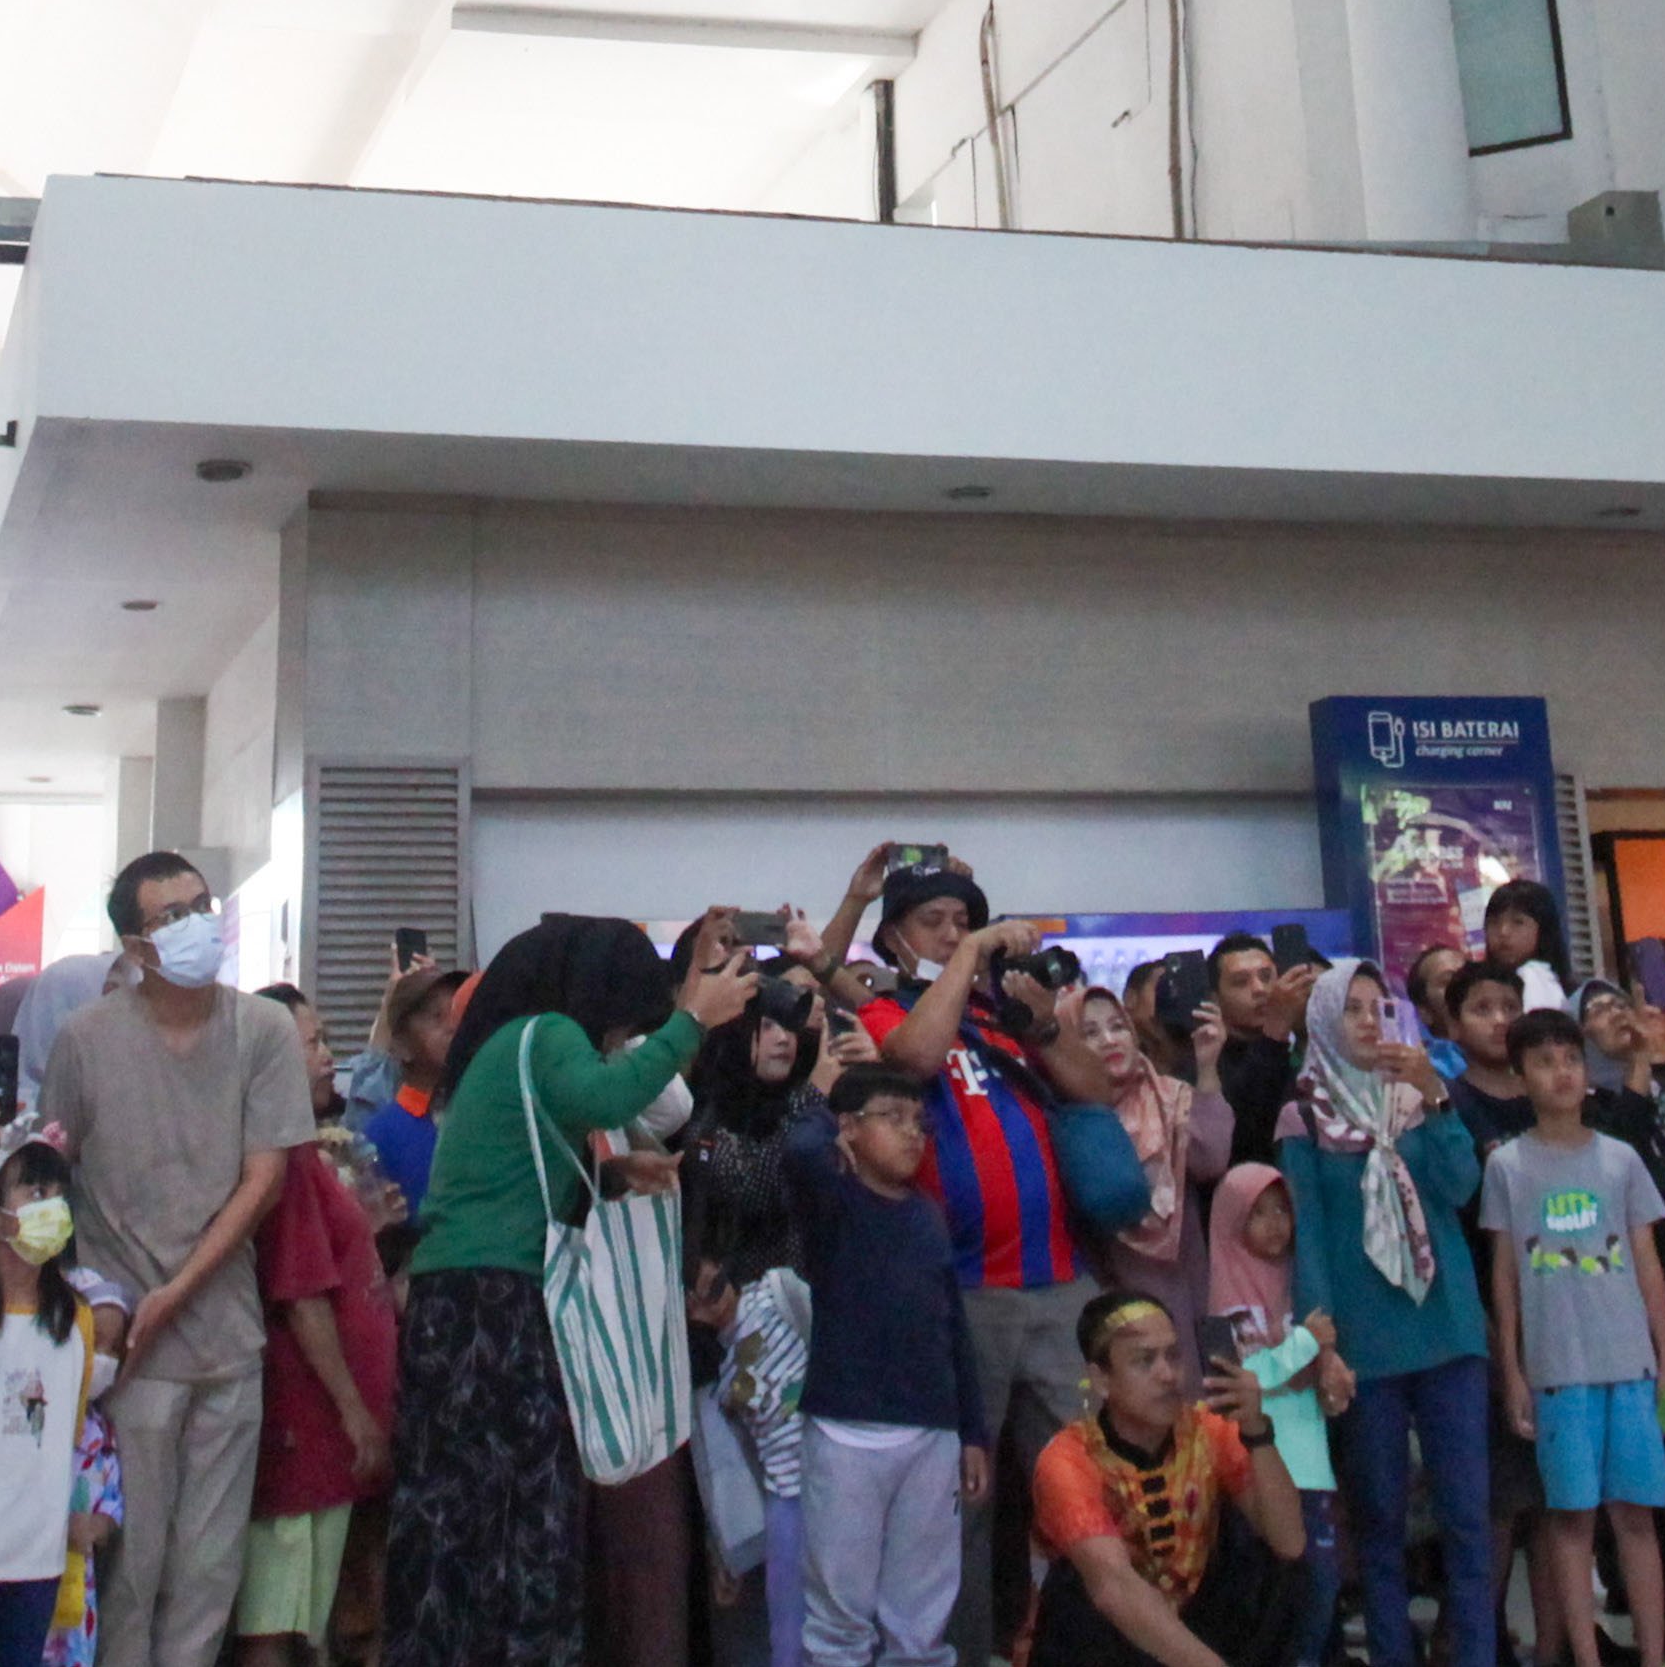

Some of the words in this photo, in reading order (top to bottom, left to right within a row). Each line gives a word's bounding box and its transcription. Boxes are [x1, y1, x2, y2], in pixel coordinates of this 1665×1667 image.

[1412, 720, 1436, 738] ISI
[1441, 720, 1520, 738] BATERAI
[1415, 744, 1465, 759] charging
[1466, 745, 1504, 758] corner
